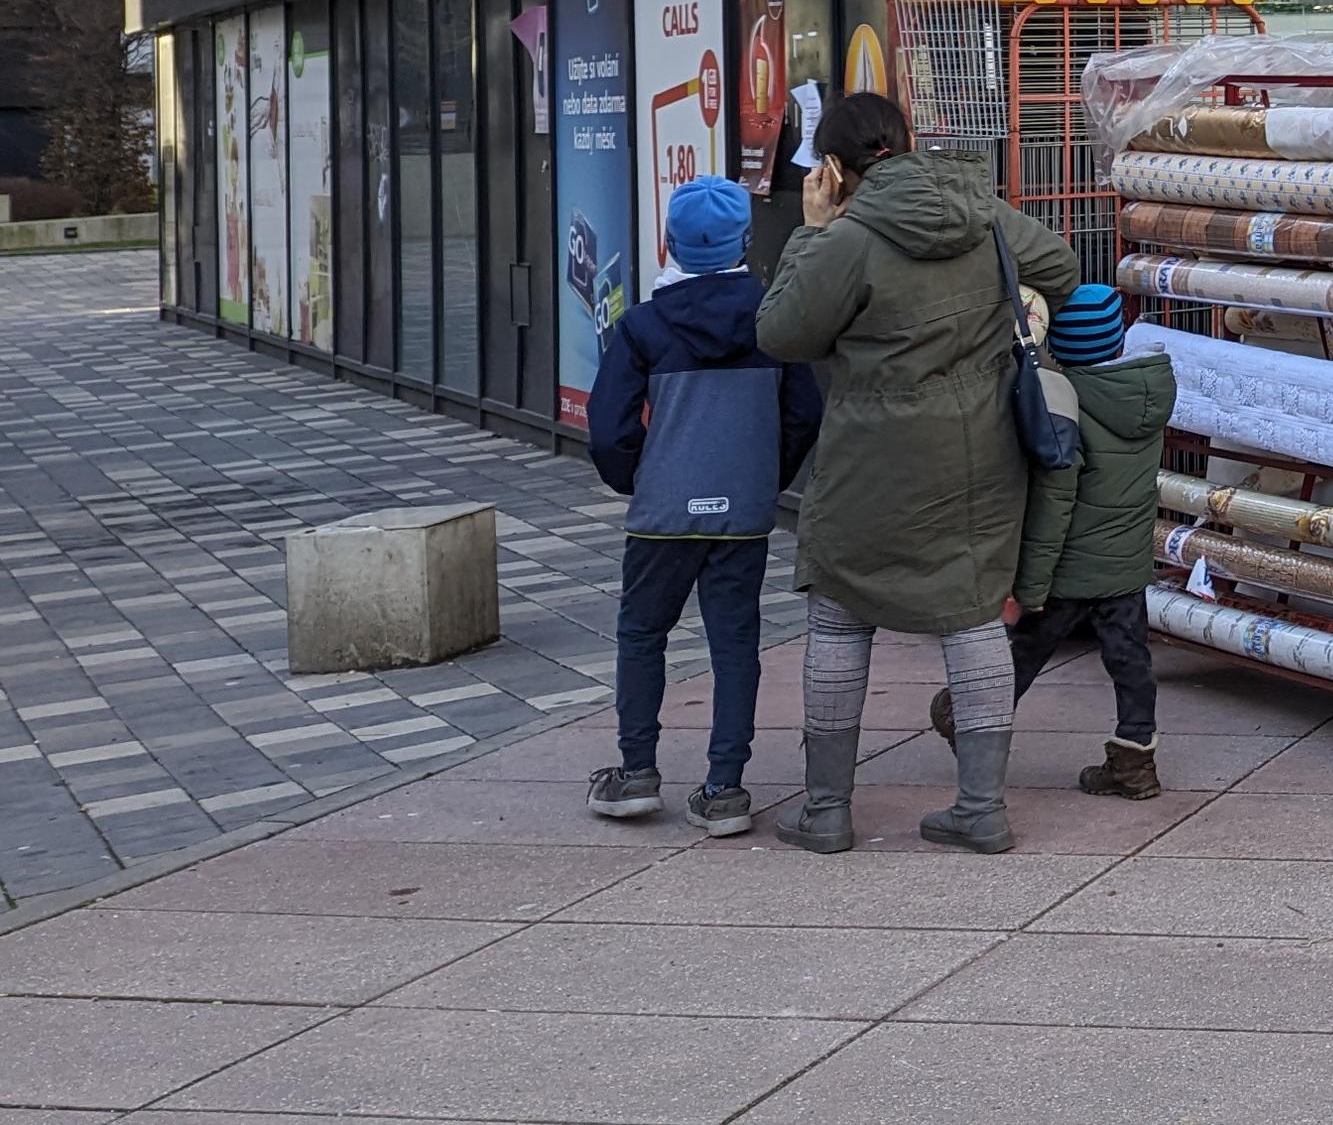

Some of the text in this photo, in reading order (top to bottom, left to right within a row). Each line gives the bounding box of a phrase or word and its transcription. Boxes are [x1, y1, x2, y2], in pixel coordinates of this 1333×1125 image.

[663, 2, 698, 37] CALLS
[568, 53, 619, 86] Užijte si volání
[563, 89, 625, 115] nebo data zdarma
[701, 69, 708, 109] 1
[574, 126, 616, 155] každý měsíc
[568, 226, 584, 265] GO
[595, 297, 609, 335] GO
